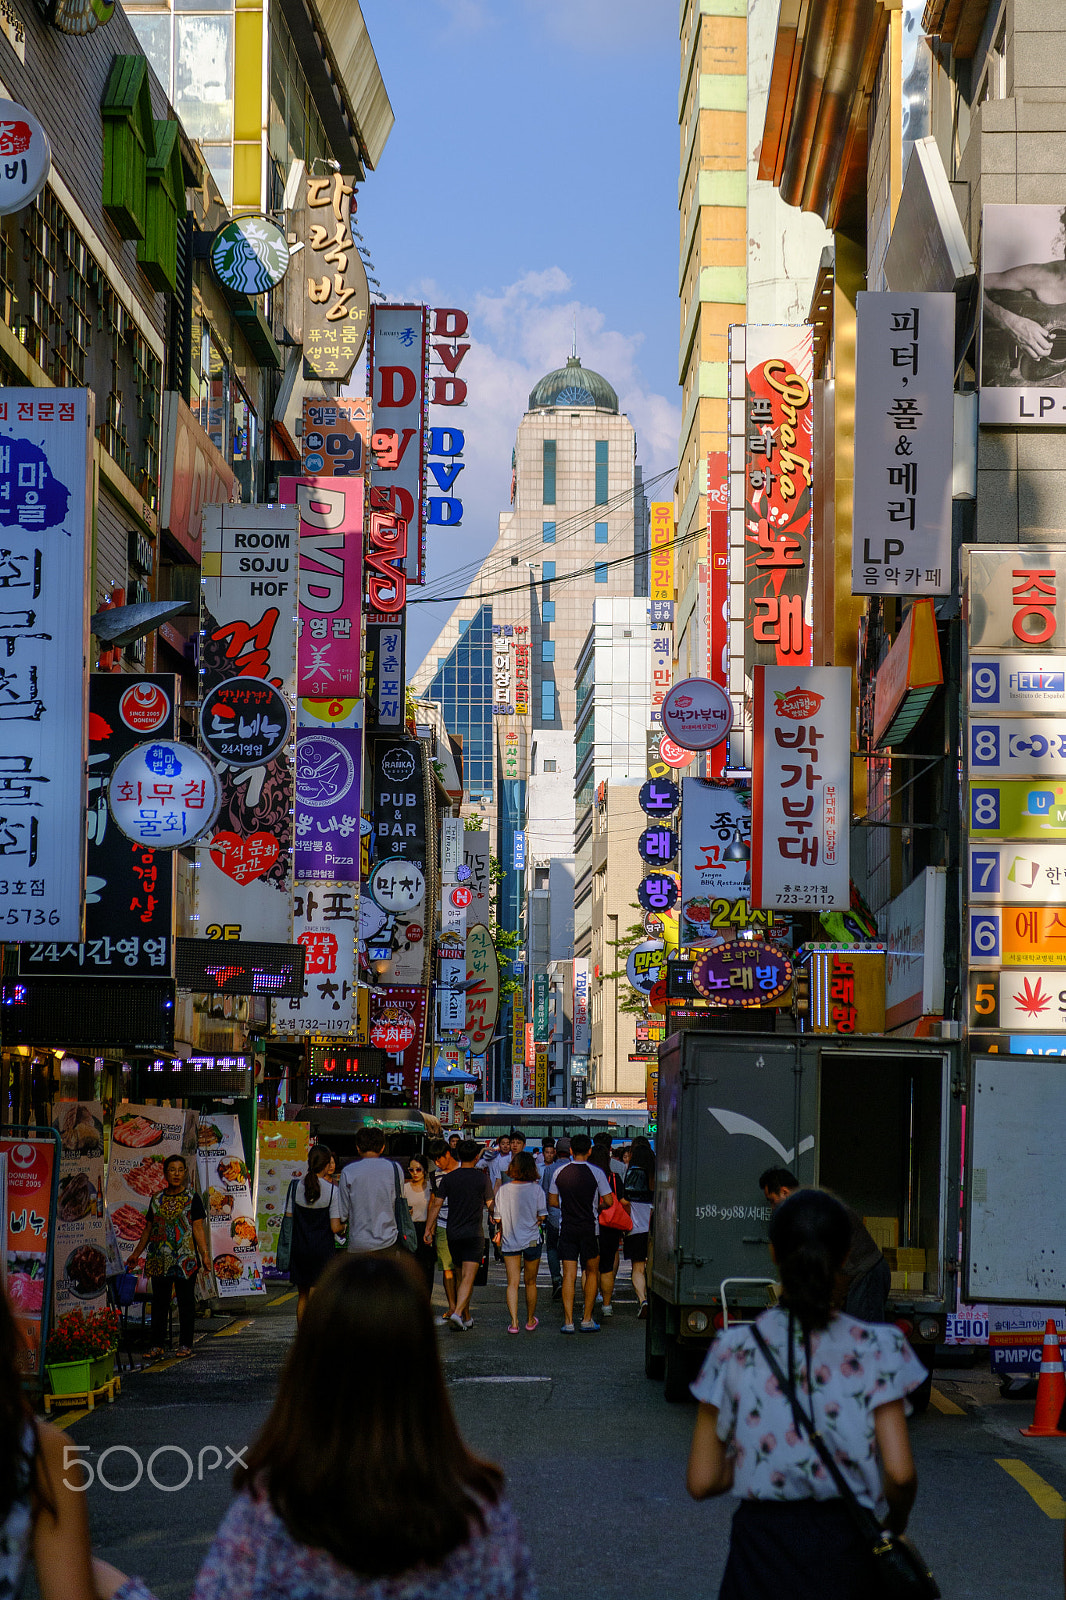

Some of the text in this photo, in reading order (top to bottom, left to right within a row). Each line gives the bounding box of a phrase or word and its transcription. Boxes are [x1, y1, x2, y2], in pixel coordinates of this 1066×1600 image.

[349, 306, 367, 320] 6F
[307, 346, 354, 360] 생맥주
[430, 308, 471, 406] DVD
[308, 362, 339, 374] 소주
[17, 402, 75, 421] 전문점
[308, 406, 366, 426] 엠플러스
[427, 427, 465, 526] DVD
[234, 533, 290, 549] ROOM
[296, 484, 346, 614] DVD
[653, 506, 671, 588] 유리공간
[863, 538, 905, 564] LP
[238, 558, 289, 573] SOJU
[365, 511, 407, 613] DVD
[753, 518, 804, 653] 노래
[863, 567, 942, 588] 음악카페
[250, 582, 289, 597] HOF
[302, 643, 335, 682] 美
[380, 634, 400, 717] 청춘포차
[975, 668, 997, 698] 9
[311, 682, 329, 694] 3F
[668, 708, 727, 723] 박가부대
[975, 730, 997, 761] 8
[385, 760, 412, 769] RANKA
[506, 748, 518, 778] 사우나
[117, 779, 206, 810] 회무침
[380, 792, 417, 807] PUB
[774, 725, 824, 867] 박가부대
[394, 809, 402, 820] &
[975, 794, 997, 824] 8
[133, 809, 187, 837] 물회
[378, 823, 417, 836] BAR
[248, 839, 278, 857] 문화
[325, 841, 333, 852] &
[391, 841, 407, 852] 3F
[515, 834, 524, 861] 국선도
[646, 784, 673, 908] 노래방
[232, 857, 264, 880] 공간
[325, 854, 354, 865] Pizza
[976, 858, 997, 886] 7
[377, 876, 422, 900] 막창
[776, 894, 835, 905] 723-2112
[711, 898, 775, 928] 24시
[974, 921, 996, 951] 6
[29, 936, 167, 967] 24시간영업
[437, 949, 464, 958] KIRIN
[721, 950, 761, 964] 프라하
[576, 971, 587, 997] YBM
[708, 965, 780, 990] 노래방
[378, 998, 416, 1010] Luxury
[831, 953, 858, 1034] 노래방
[974, 984, 996, 1015] 5
[298, 1018, 350, 1032] 732-1197
[371, 1026, 413, 1042] 羊肉串
[9, 1172, 38, 1180] DONENU
